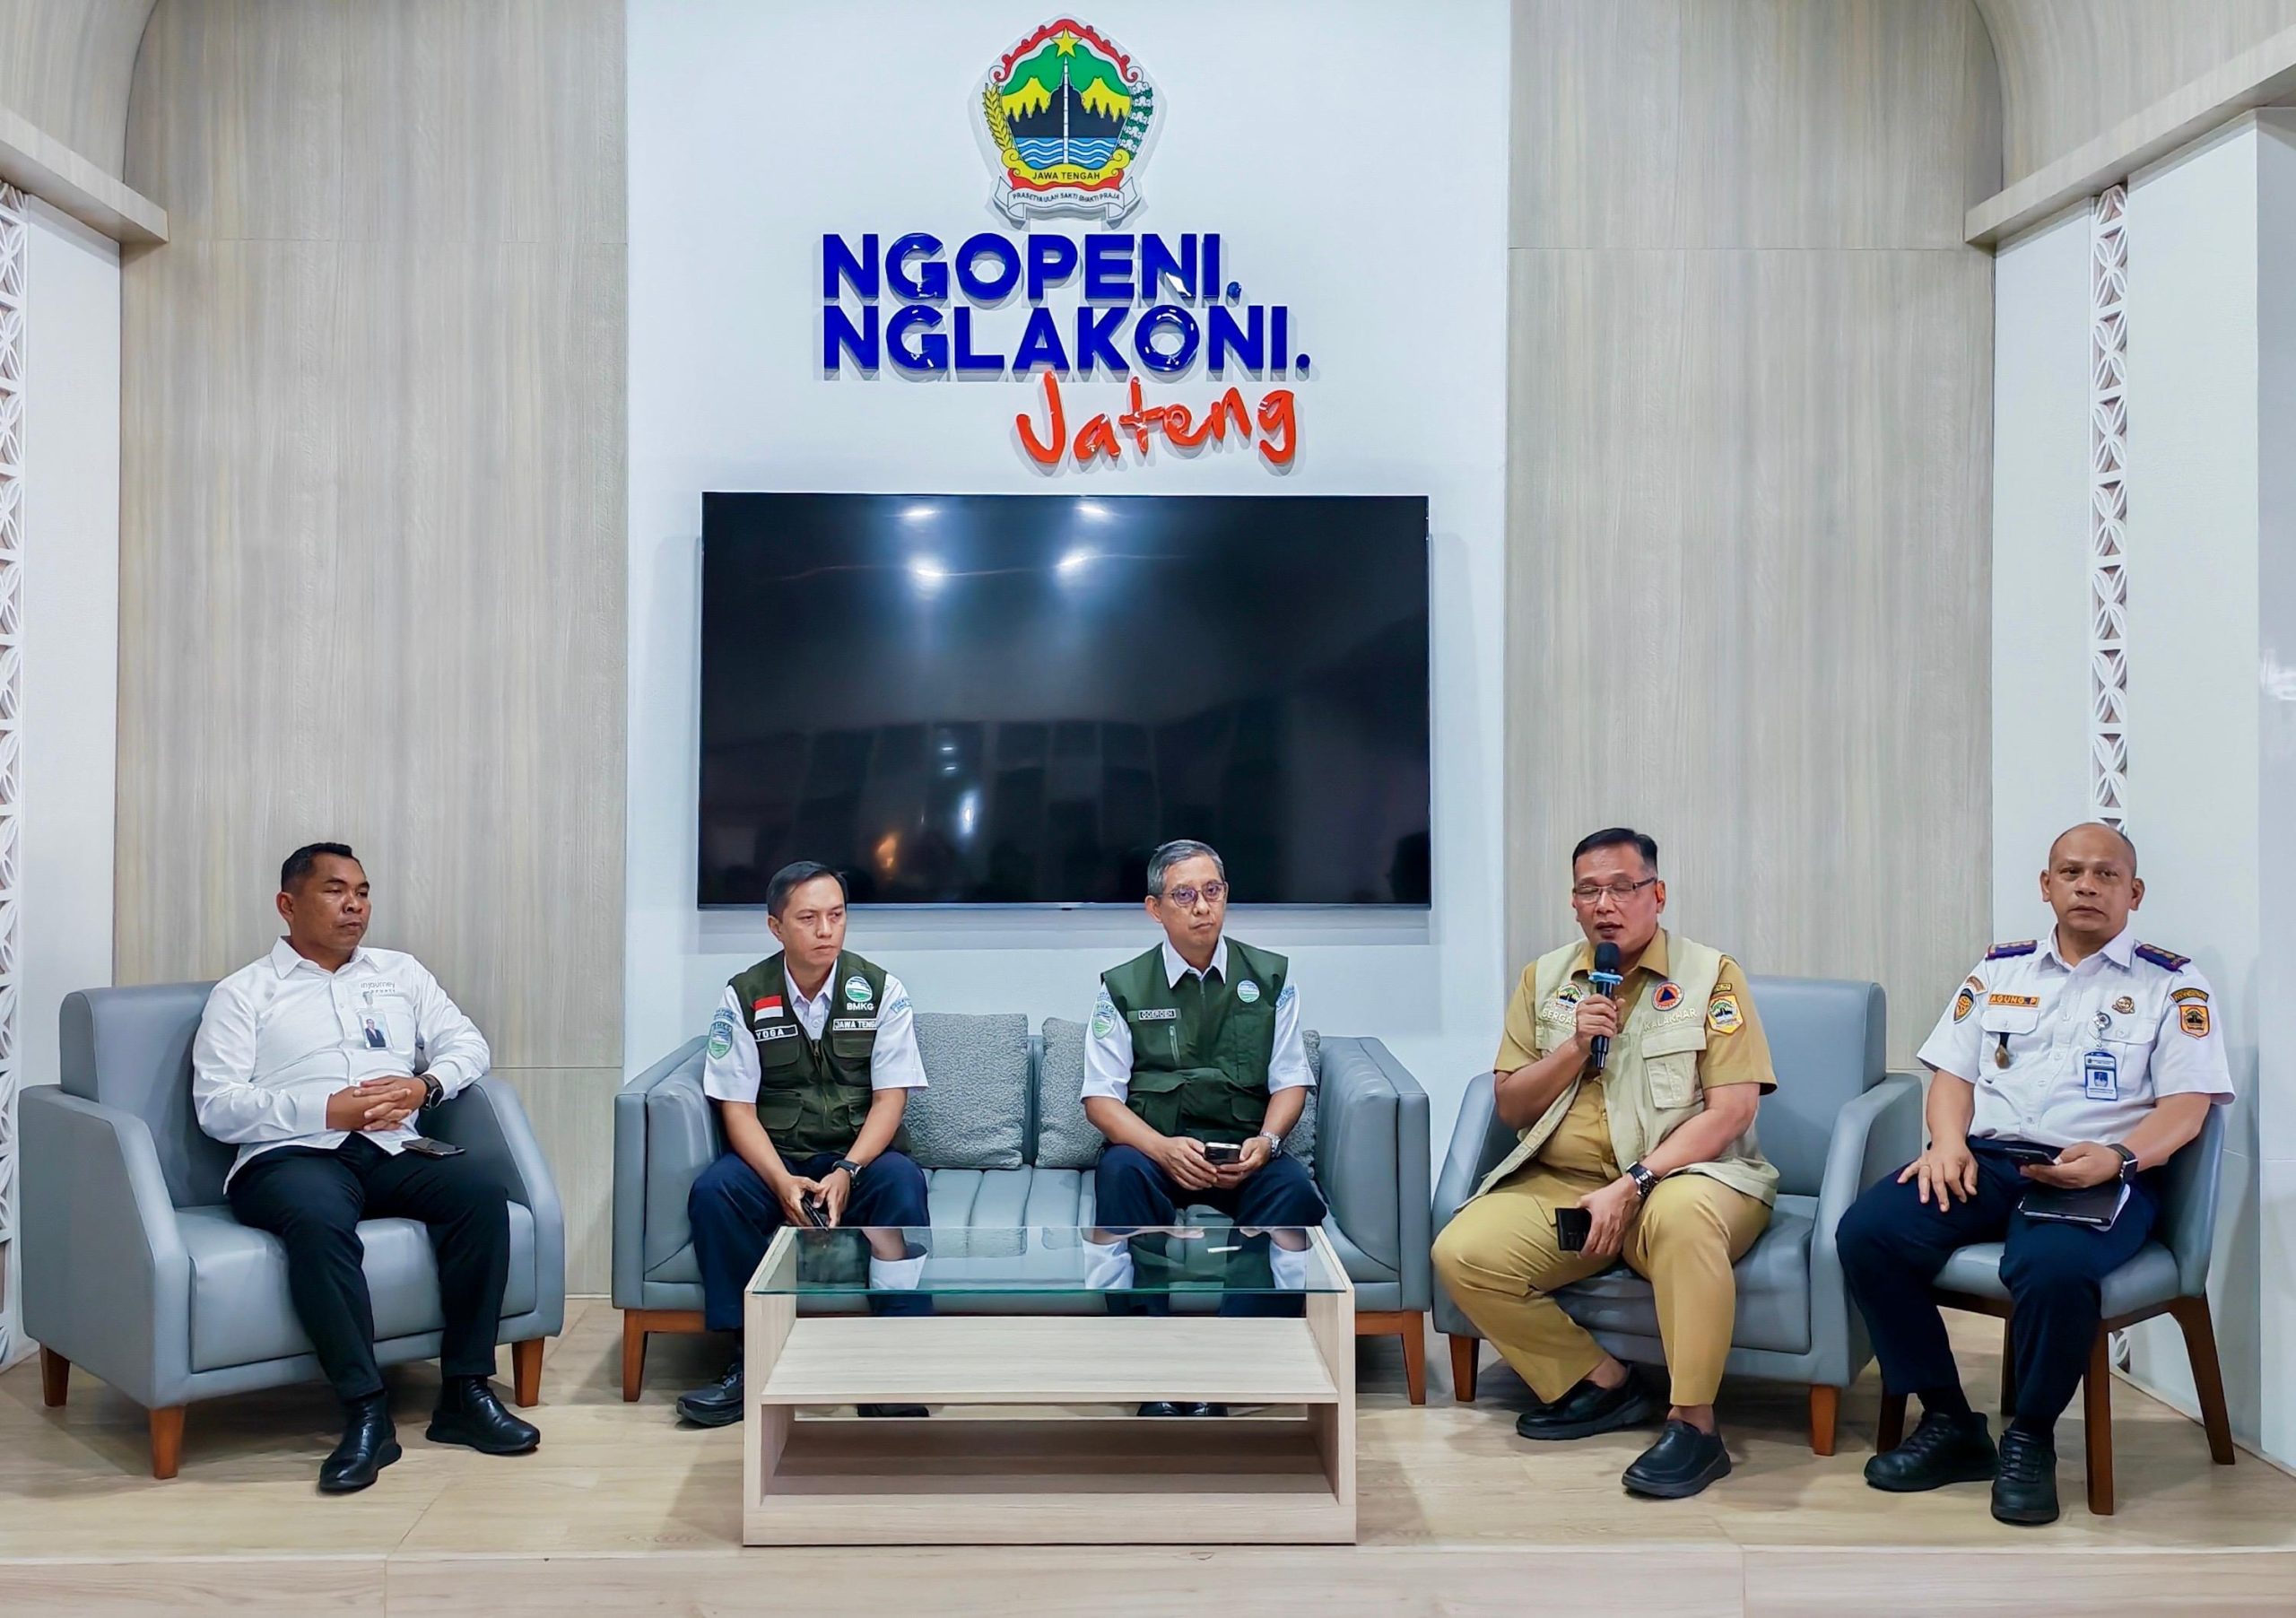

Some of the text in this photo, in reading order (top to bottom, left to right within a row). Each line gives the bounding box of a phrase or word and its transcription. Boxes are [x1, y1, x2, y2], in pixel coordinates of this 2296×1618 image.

[823, 233, 1241, 300] NGOPENI.
[823, 305, 1310, 371] NGLAKONI.
[1015, 370, 1297, 465] Jateng
[847, 1003, 874, 1011] BMKG
[835, 1021, 857, 1029] JAWA
[1643, 1008, 1698, 1032] KALAKHAR
[756, 1029, 784, 1040] YOGA
